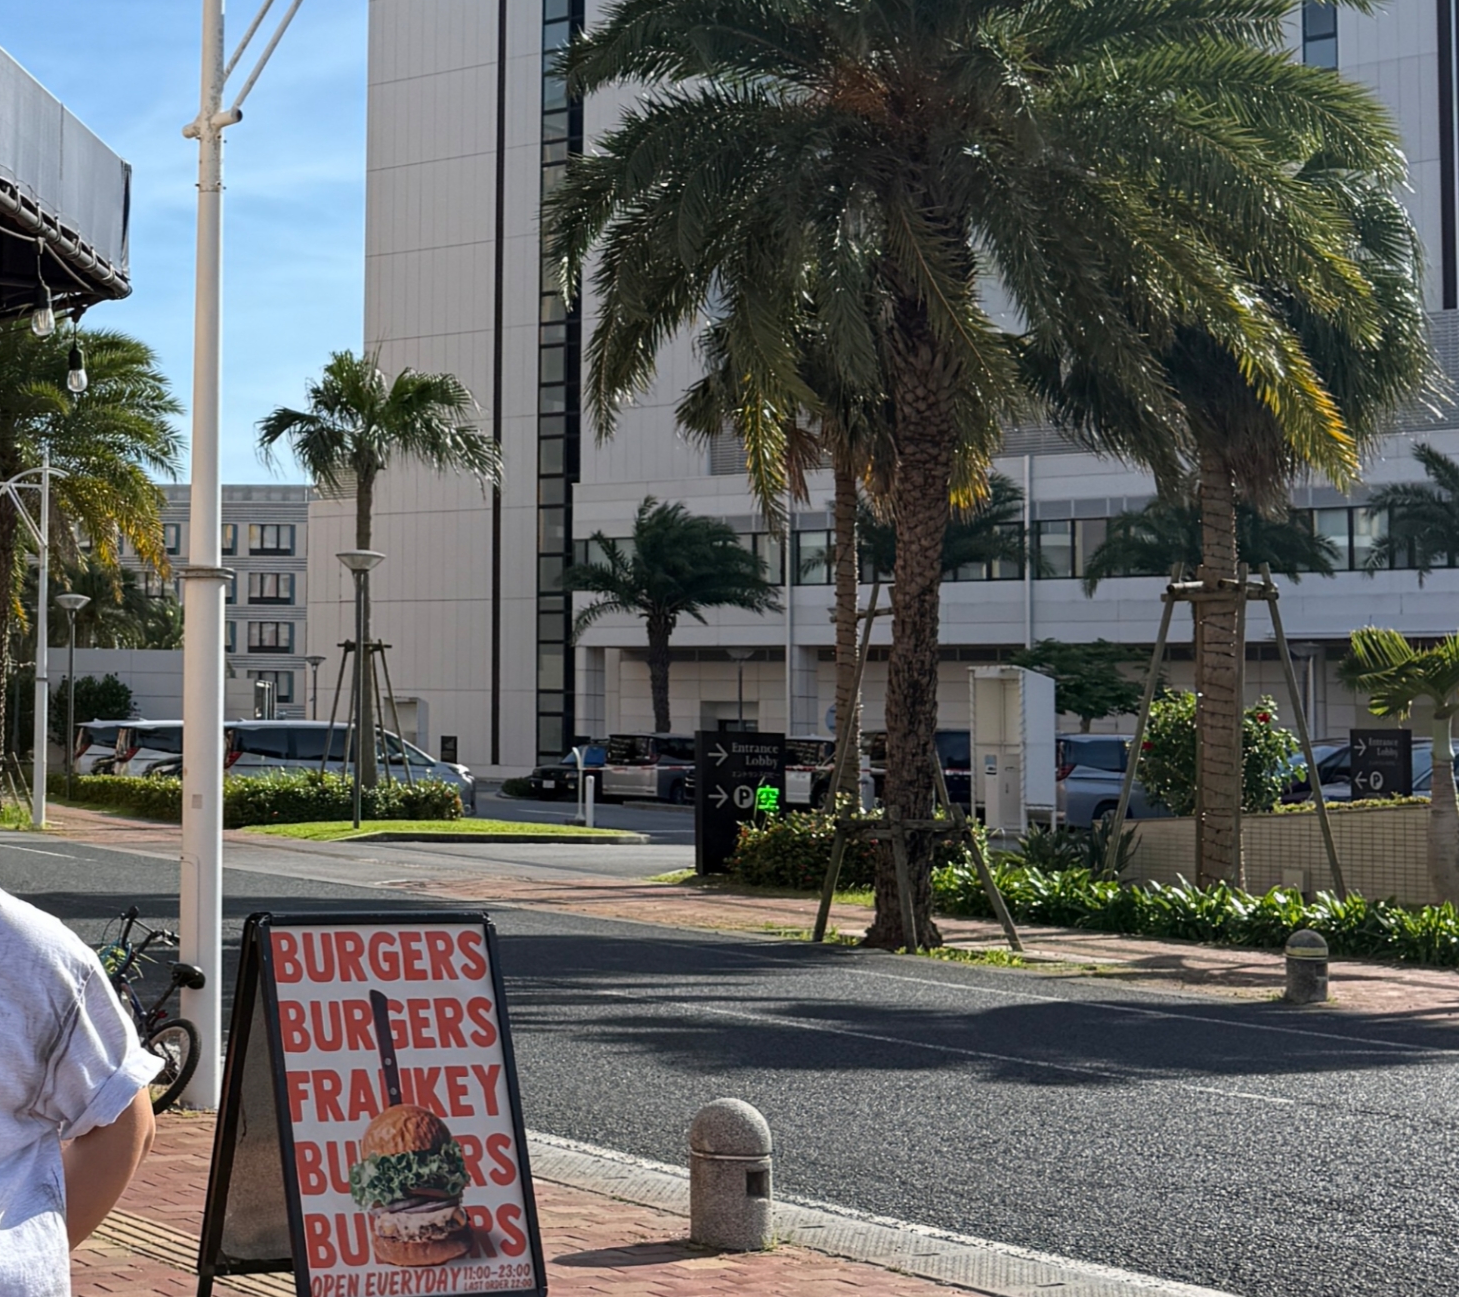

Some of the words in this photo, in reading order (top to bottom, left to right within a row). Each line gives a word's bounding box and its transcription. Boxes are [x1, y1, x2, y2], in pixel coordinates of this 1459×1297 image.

[731, 742, 779, 754] Entrance
[745, 755, 779, 770] Lobby
[270, 930, 486, 984] BURGERS
[278, 996, 497, 1053] BURGERS
[295, 1133, 517, 1196] BURS
[304, 1203, 527, 1269] BURS
[365, 1267, 461, 1297] EVERYDAY
[464, 1280, 484, 1291] LAST
[485, 1279, 509, 1290] ORDER
